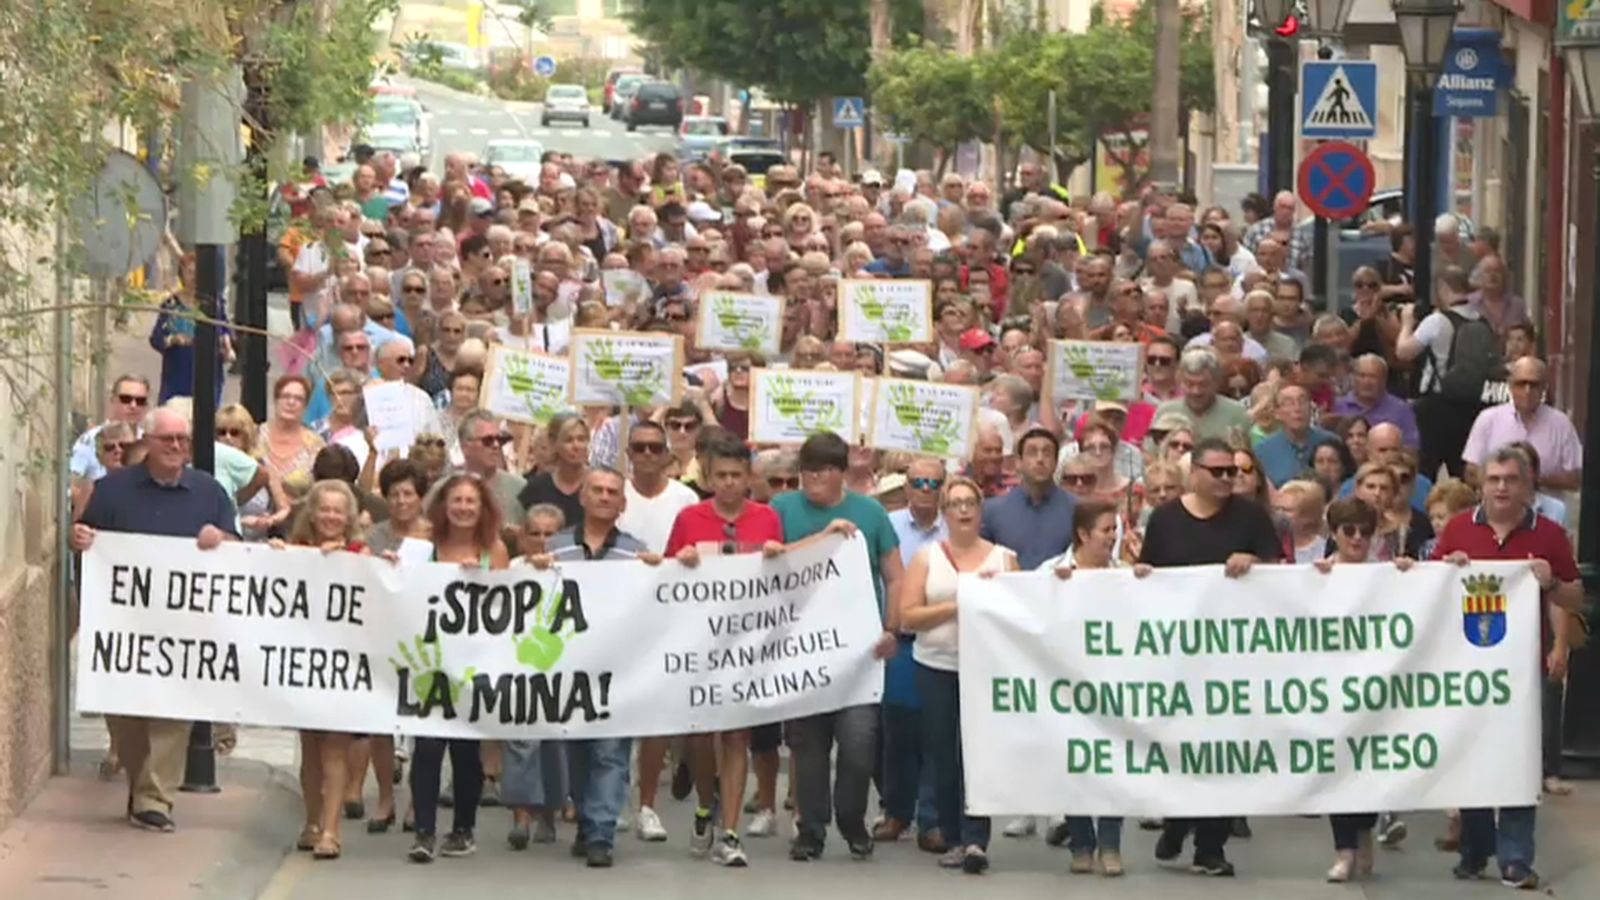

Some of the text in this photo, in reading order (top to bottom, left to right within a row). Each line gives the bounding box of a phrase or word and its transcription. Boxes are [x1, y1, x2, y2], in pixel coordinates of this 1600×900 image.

[1437, 73, 1495, 90] Allianz
[110, 564, 366, 626] EN DEFENSA DE
[655, 557, 841, 605] COORDINADORA
[423, 579, 589, 644] ¡STOP A
[708, 602, 801, 638] VECINAL
[1084, 612, 1414, 657] EL AYUNTAMIENTO
[91, 630, 373, 692] NUESTRA TIERRA
[664, 627, 849, 674] DE SAN MIGUEL
[395, 666, 613, 726] LA MINA!
[689, 664, 833, 708] DE SALINAS
[991, 668, 1512, 719] EN CONTRA DE LOS SONDEOS
[1067, 732, 1439, 775] DE LA MINA DE YESO
